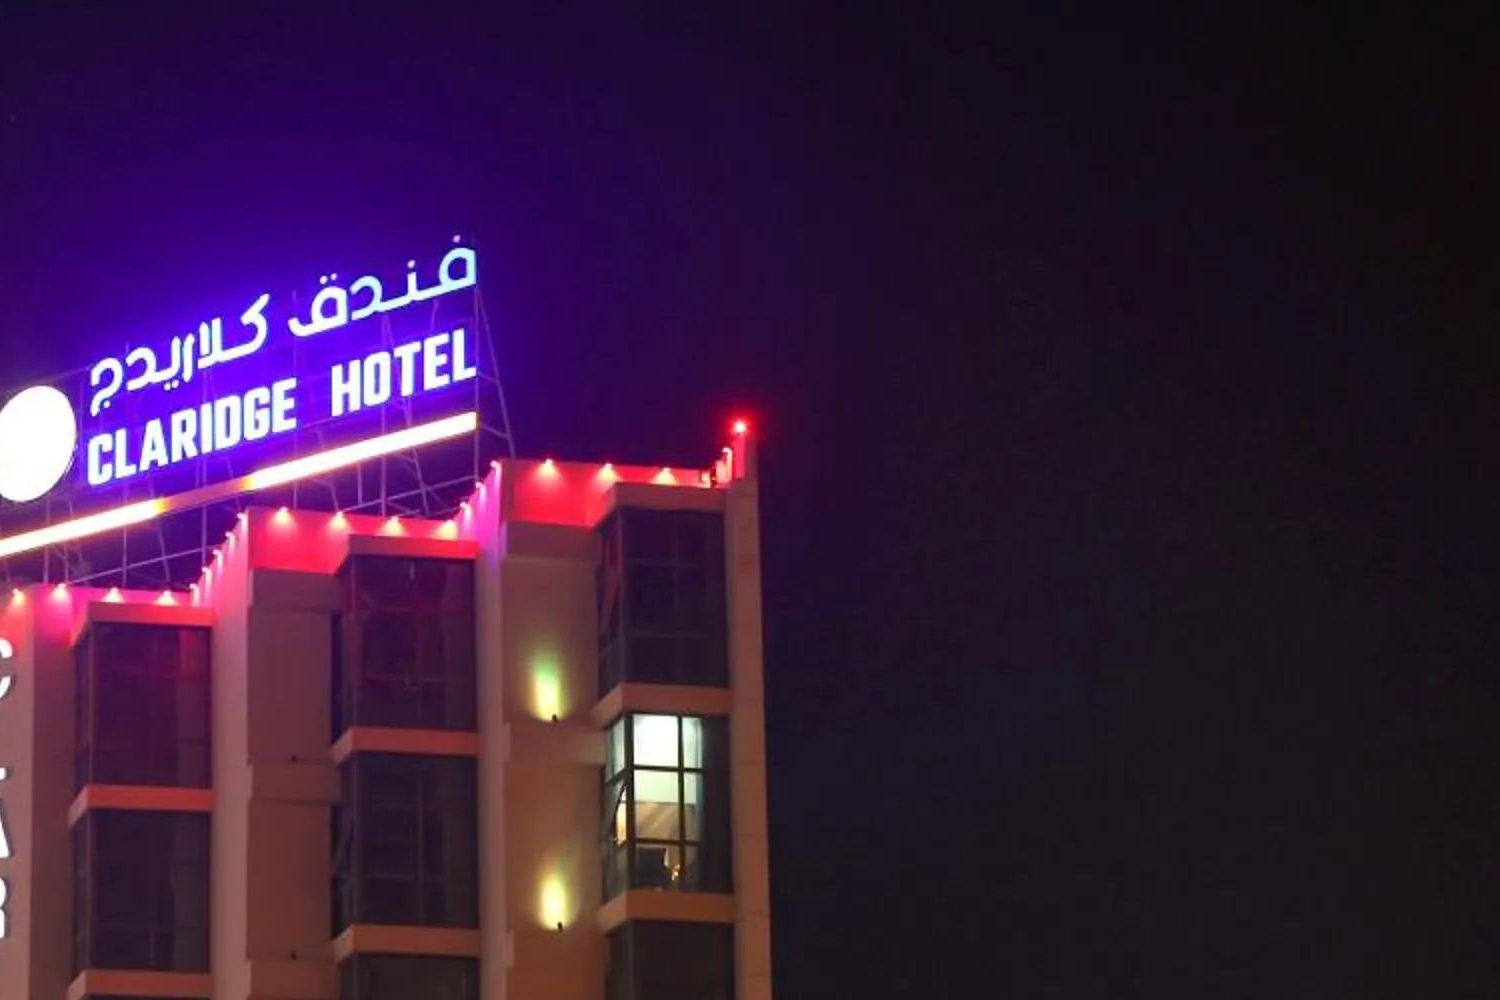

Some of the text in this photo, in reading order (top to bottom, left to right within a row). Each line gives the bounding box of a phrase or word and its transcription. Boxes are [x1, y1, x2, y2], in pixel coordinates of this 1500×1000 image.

[86, 328, 477, 487] CLARIDGE HOTEL
[91, 235, 476, 417] فندق كلاريدج
